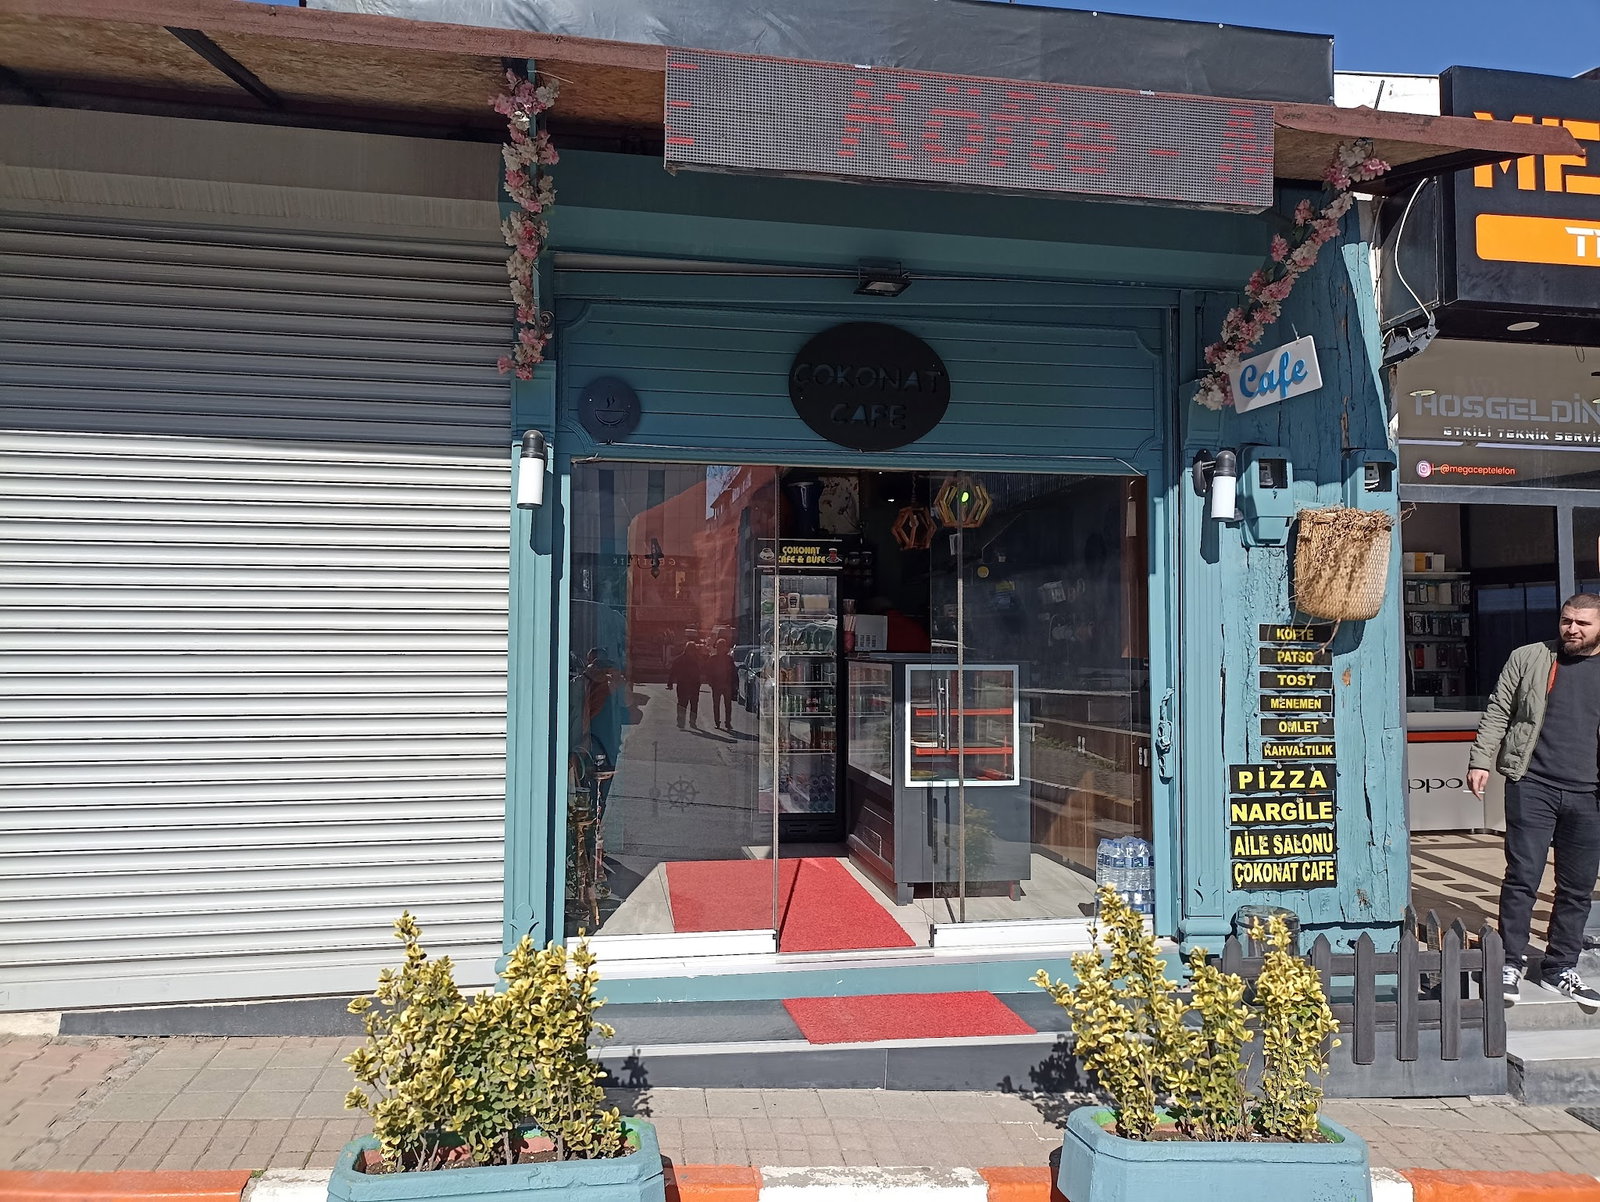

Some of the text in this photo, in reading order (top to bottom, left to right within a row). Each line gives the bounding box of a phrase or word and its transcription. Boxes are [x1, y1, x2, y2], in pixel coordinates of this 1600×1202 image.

[1239, 351, 1308, 398] Cafe
[830, 402, 908, 430] CAFE
[1497, 427, 1549, 440] TEKNİK
[1440, 463, 1516, 476] @megaceptelefon
[1277, 674, 1316, 686] TOST
[1270, 698, 1322, 709] MENEMEN
[1278, 721, 1319, 733] OMLET
[1264, 744, 1334, 756] KAHVALTILIK
[1238, 766, 1327, 789] PİZZA
[1231, 798, 1333, 821] NARGİLE
[1234, 830, 1334, 856] AİLE SALONU
[1234, 860, 1335, 888] ÇOKONAT CAFE
